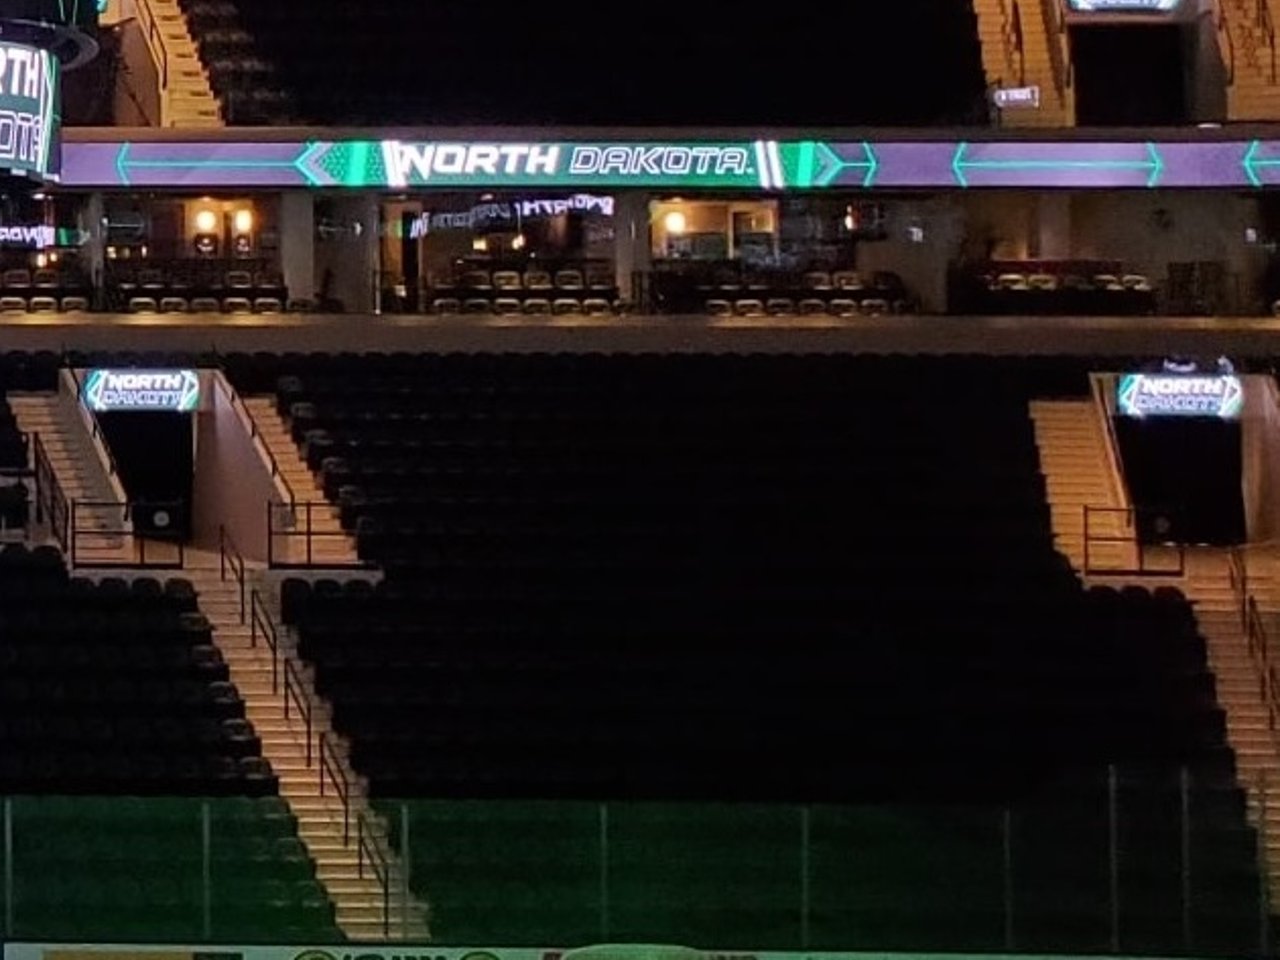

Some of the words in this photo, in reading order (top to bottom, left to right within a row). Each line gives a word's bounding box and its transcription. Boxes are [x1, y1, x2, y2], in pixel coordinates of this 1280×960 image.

[398, 146, 560, 182] NORTH
[107, 374, 181, 390] NORTH
[1141, 378, 1222, 395] NORTH
